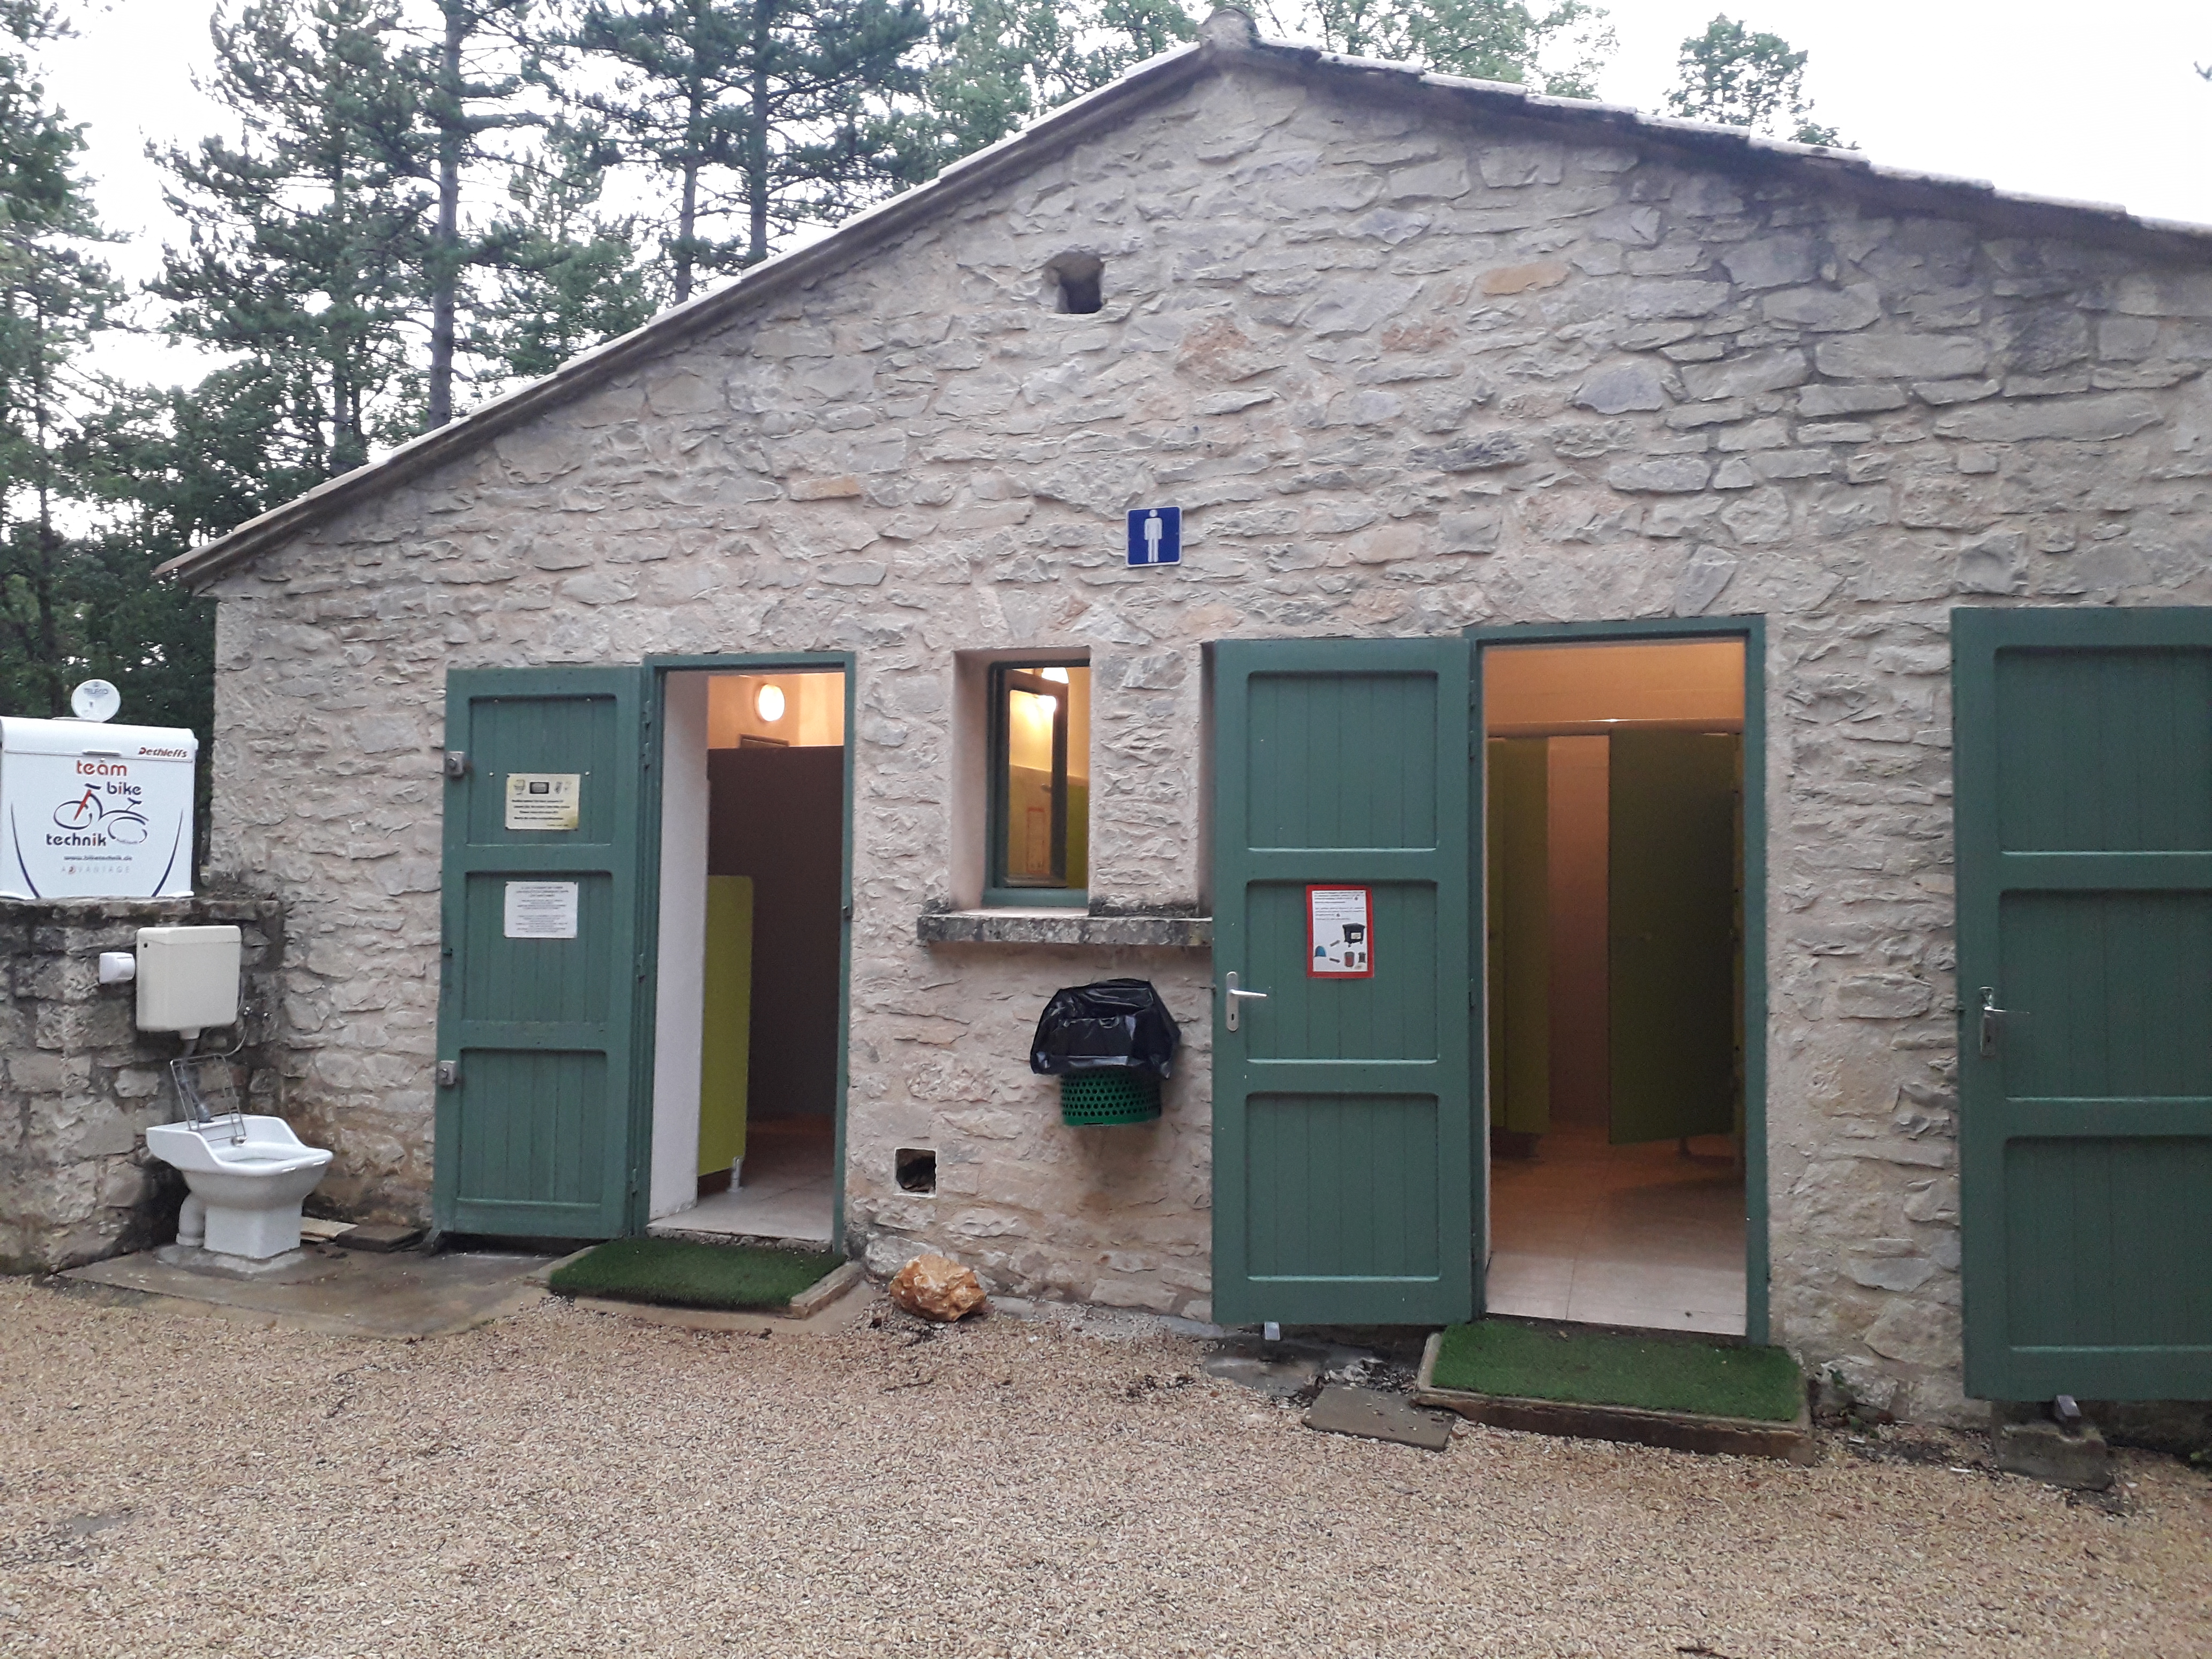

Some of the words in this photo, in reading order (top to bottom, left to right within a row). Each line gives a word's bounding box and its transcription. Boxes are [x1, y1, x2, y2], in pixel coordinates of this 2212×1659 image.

[138, 747, 188, 758] Dethleffs
[76, 760, 128, 776] team
[107, 781, 142, 795] bike
[46, 833, 107, 846] technik
